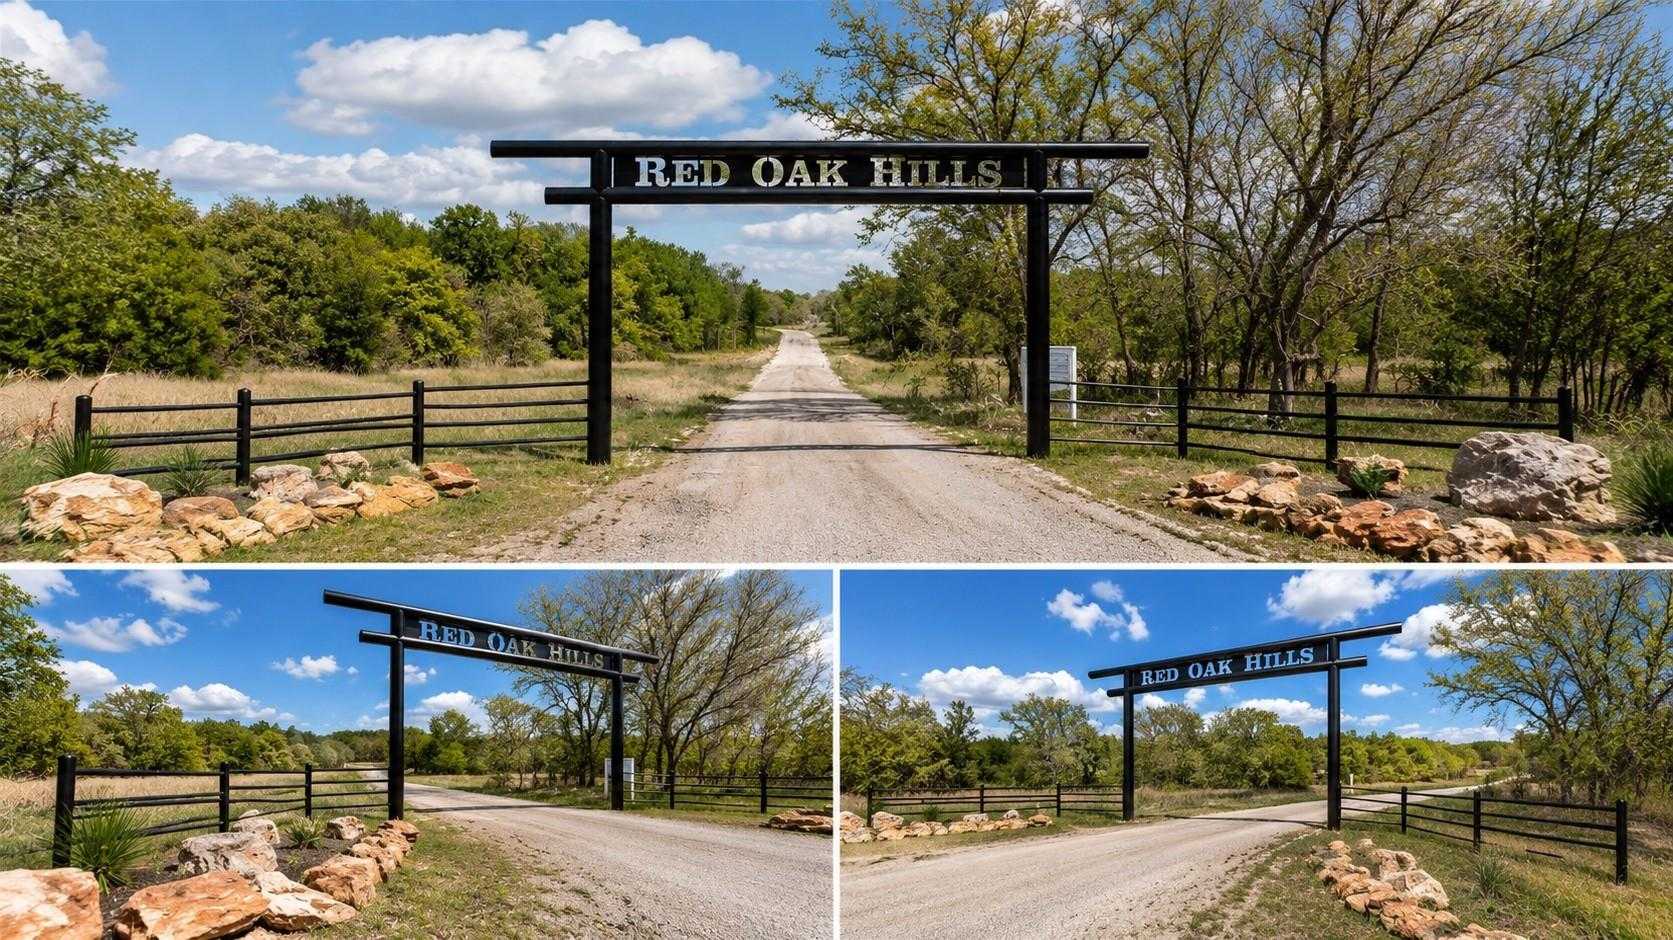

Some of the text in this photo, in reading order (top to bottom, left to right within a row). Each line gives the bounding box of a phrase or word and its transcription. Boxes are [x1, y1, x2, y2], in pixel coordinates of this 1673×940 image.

[634, 157, 1002, 188] RED OAK HILLS
[418, 620, 605, 669] RED OAK HILLS
[1140, 647, 1314, 686] RED OAK HILLS
